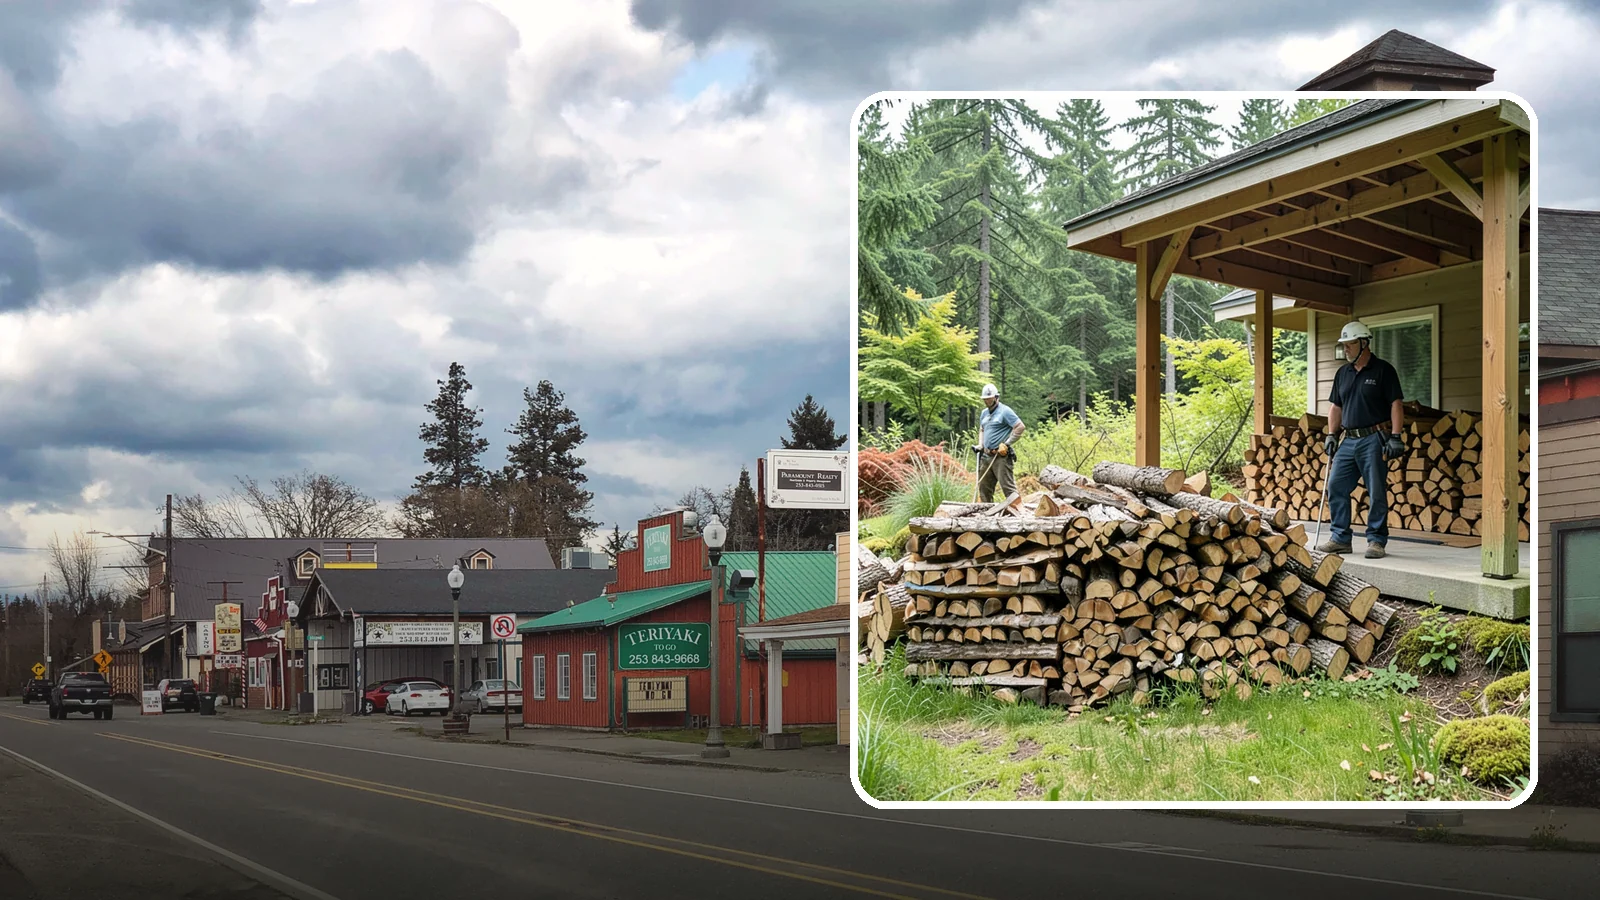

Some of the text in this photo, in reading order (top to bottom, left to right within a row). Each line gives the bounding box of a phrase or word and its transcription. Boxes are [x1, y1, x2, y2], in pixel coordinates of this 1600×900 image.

[625, 628, 702, 646] TERIYAKI
[629, 654, 700, 664] 253 843-9668
